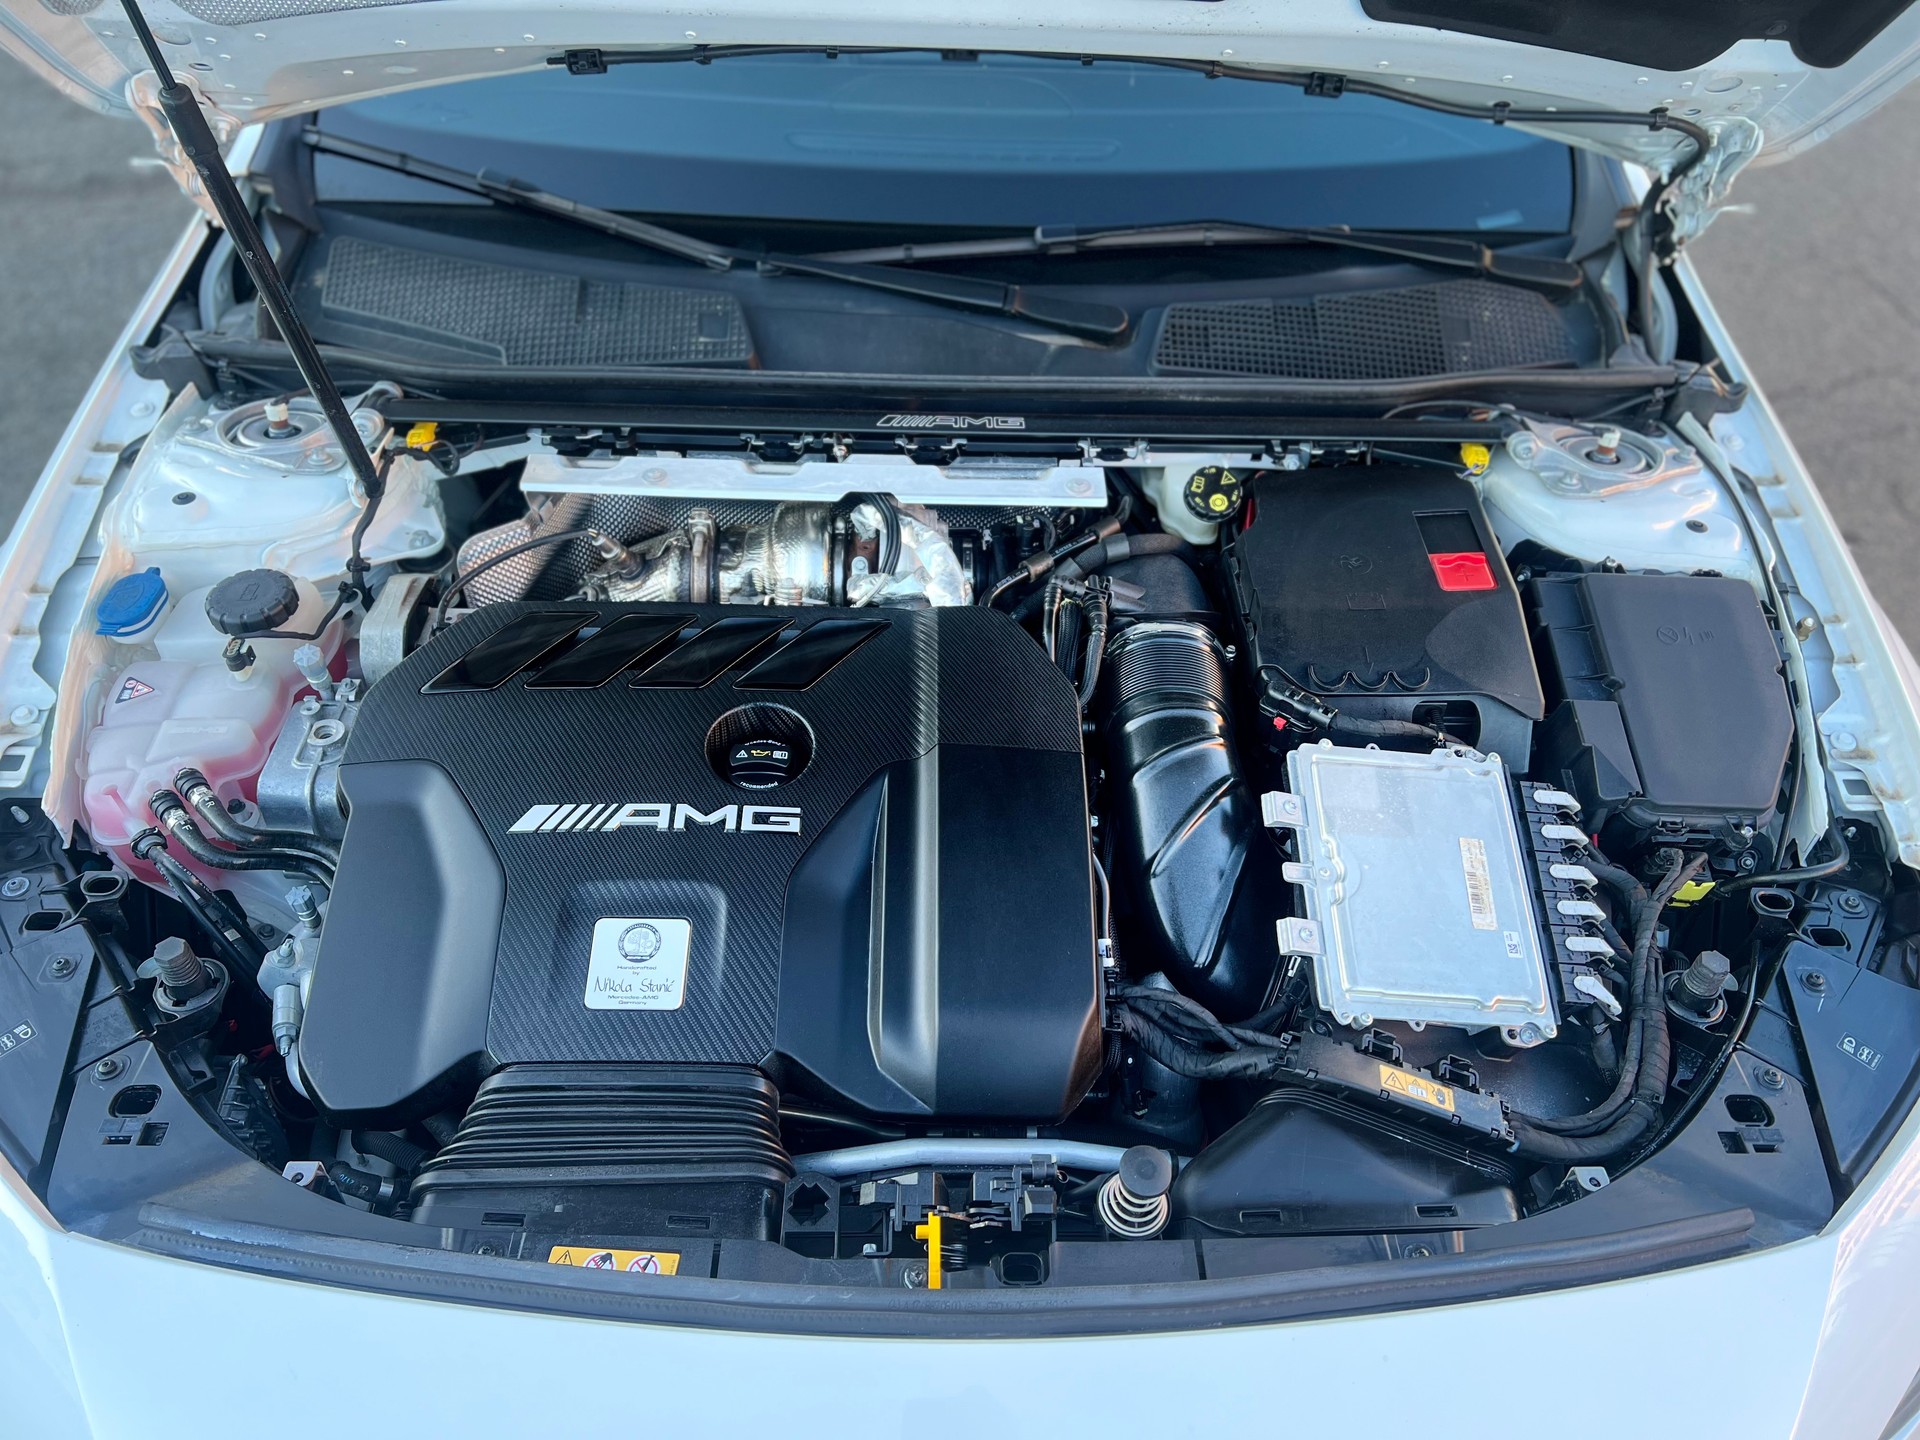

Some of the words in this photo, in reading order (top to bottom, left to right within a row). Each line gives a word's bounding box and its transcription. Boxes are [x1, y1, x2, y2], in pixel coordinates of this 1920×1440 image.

[926, 415, 1025, 429] AMG
[740, 781, 778, 789] recommended
[600, 803, 801, 833] AMG
